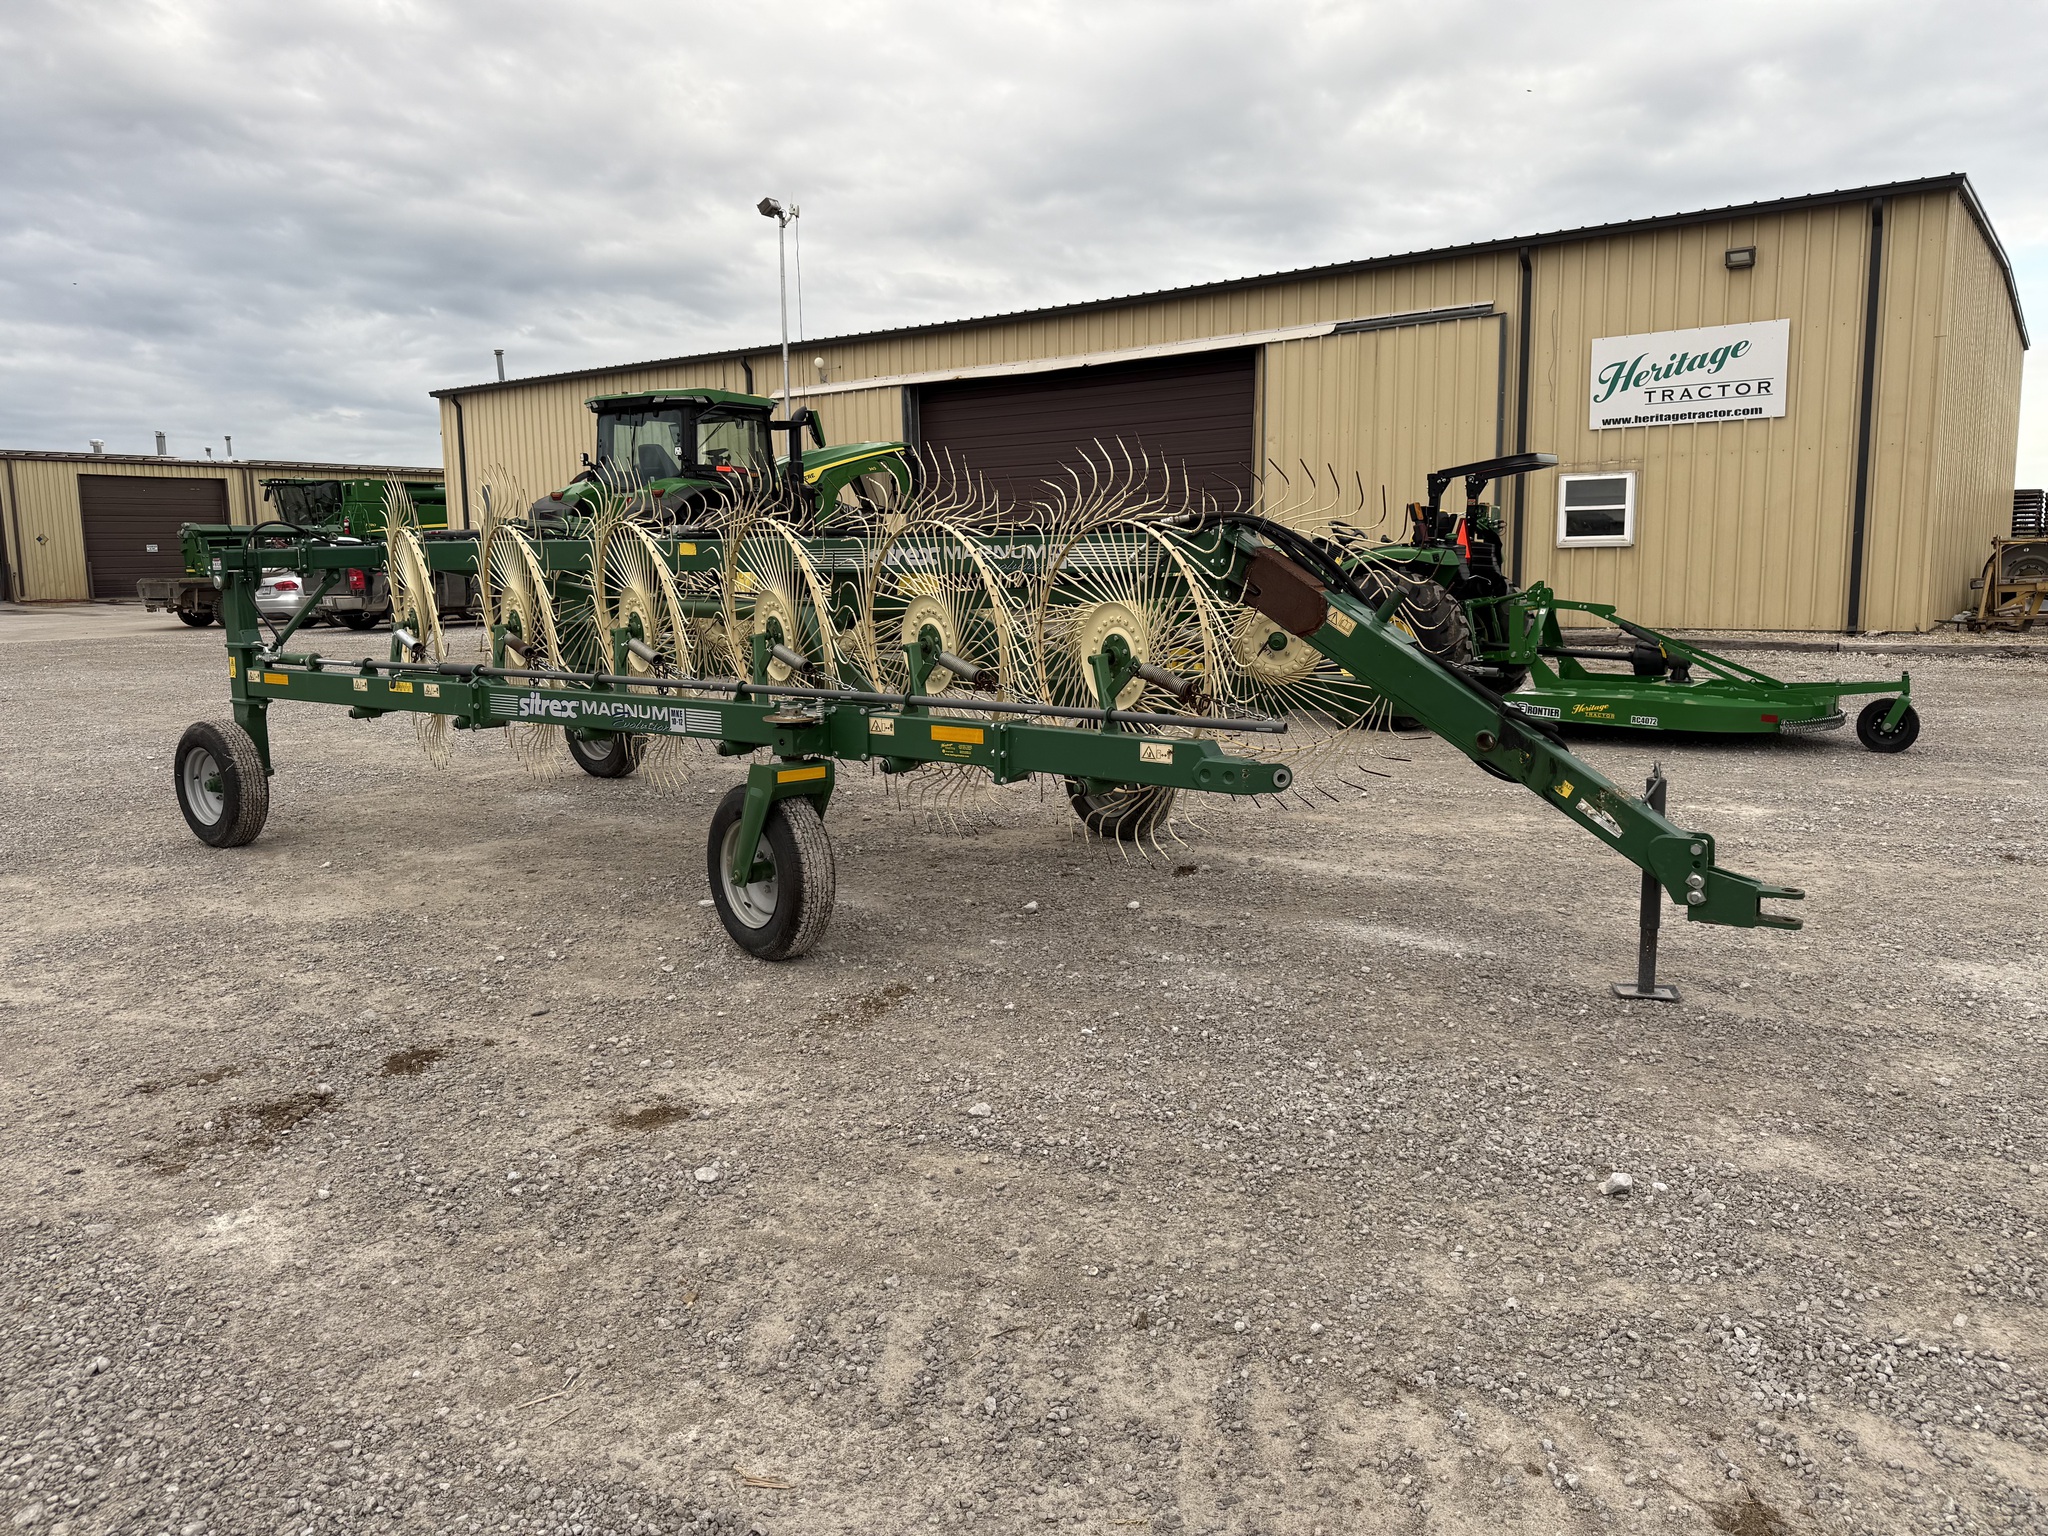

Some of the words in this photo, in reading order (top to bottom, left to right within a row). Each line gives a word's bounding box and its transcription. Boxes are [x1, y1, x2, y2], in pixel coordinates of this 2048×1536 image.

[1593, 339, 1753, 403] Heritage
[1644, 380, 1772, 404] TRACTOR
[1601, 406, 1763, 426] www.heritagetractor.com
[519, 692, 579, 718] sitrex
[582, 700, 669, 721] MAGNUM
[1571, 703, 1610, 714] Heritage
[1585, 711, 1615, 719] TRACTOR
[1631, 716, 1658, 726] RC4072
